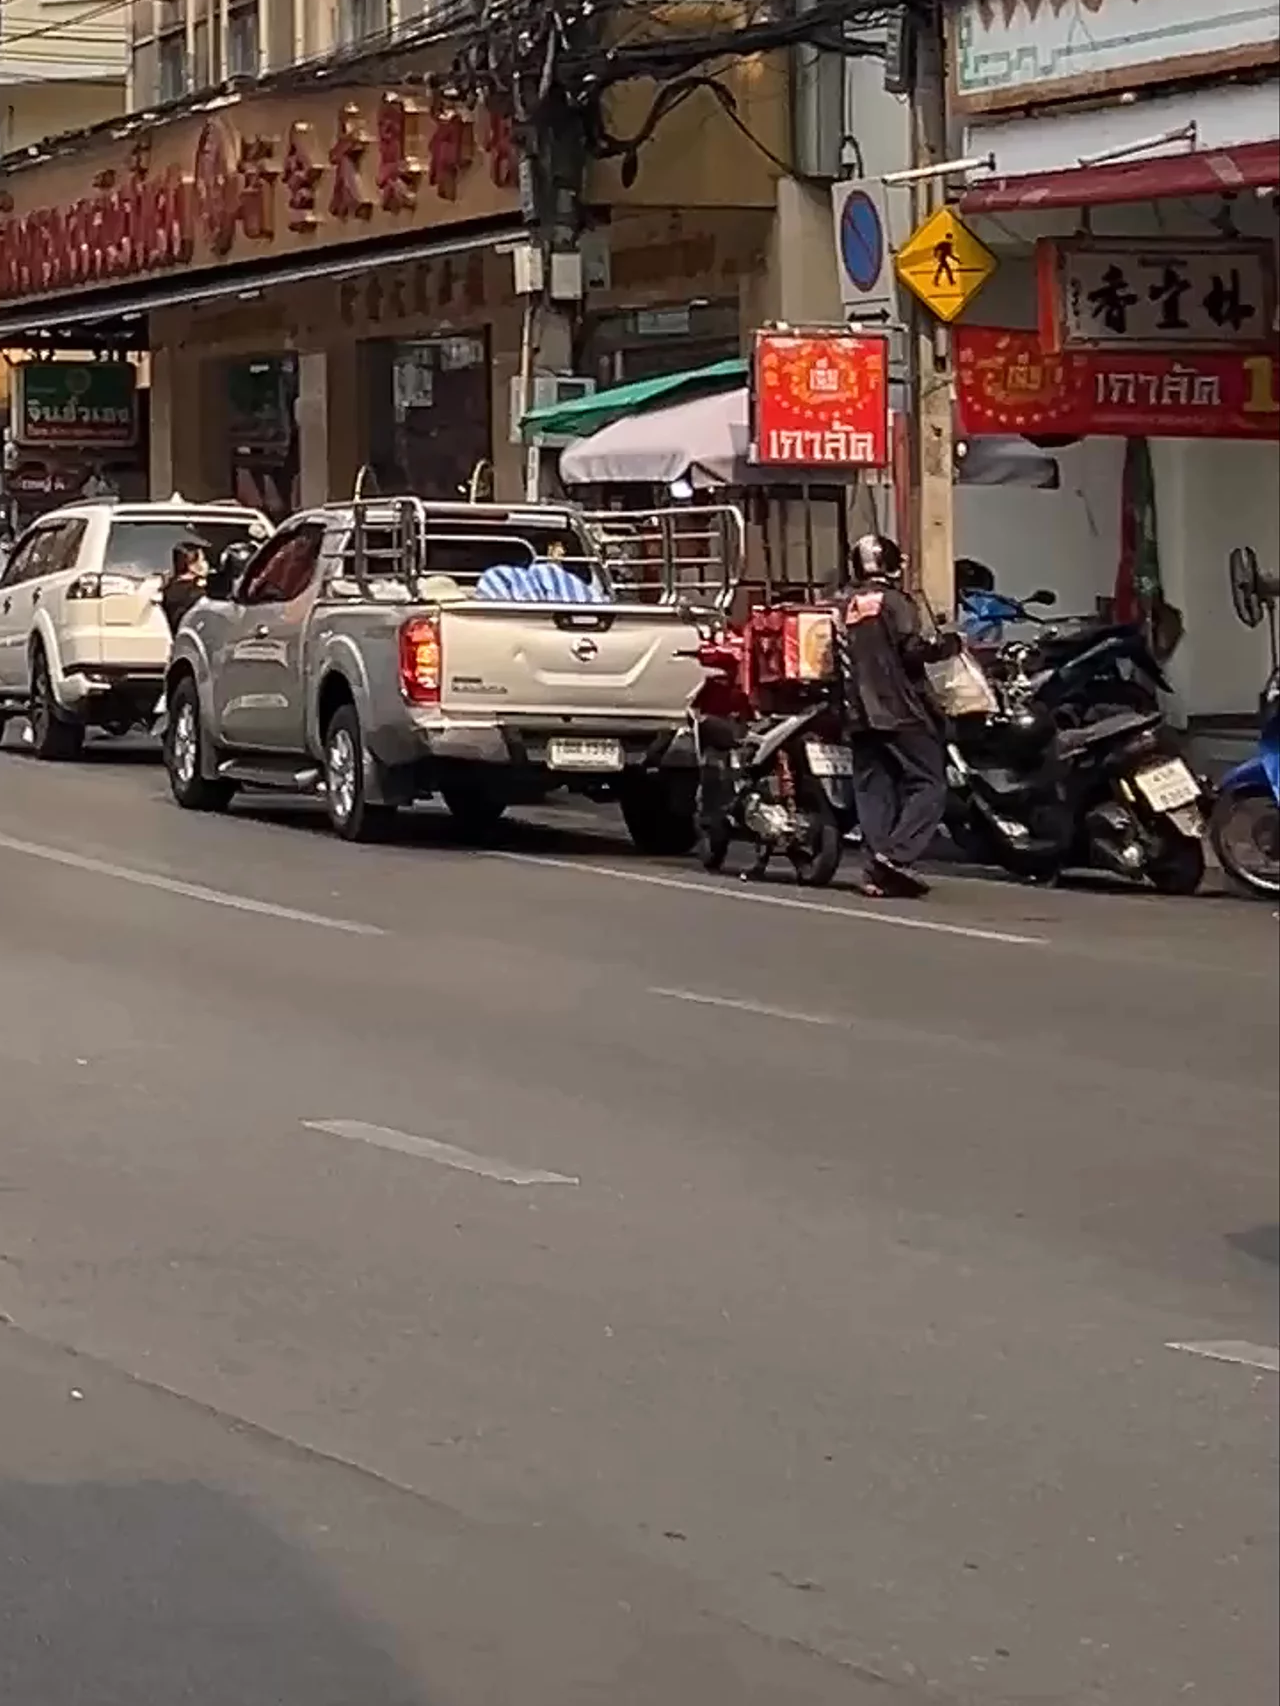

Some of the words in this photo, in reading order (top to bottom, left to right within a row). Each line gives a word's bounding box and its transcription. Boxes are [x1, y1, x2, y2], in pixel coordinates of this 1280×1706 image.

[1094, 359, 1223, 406] เกาลัด
[768, 420, 875, 463] เกาลัด
